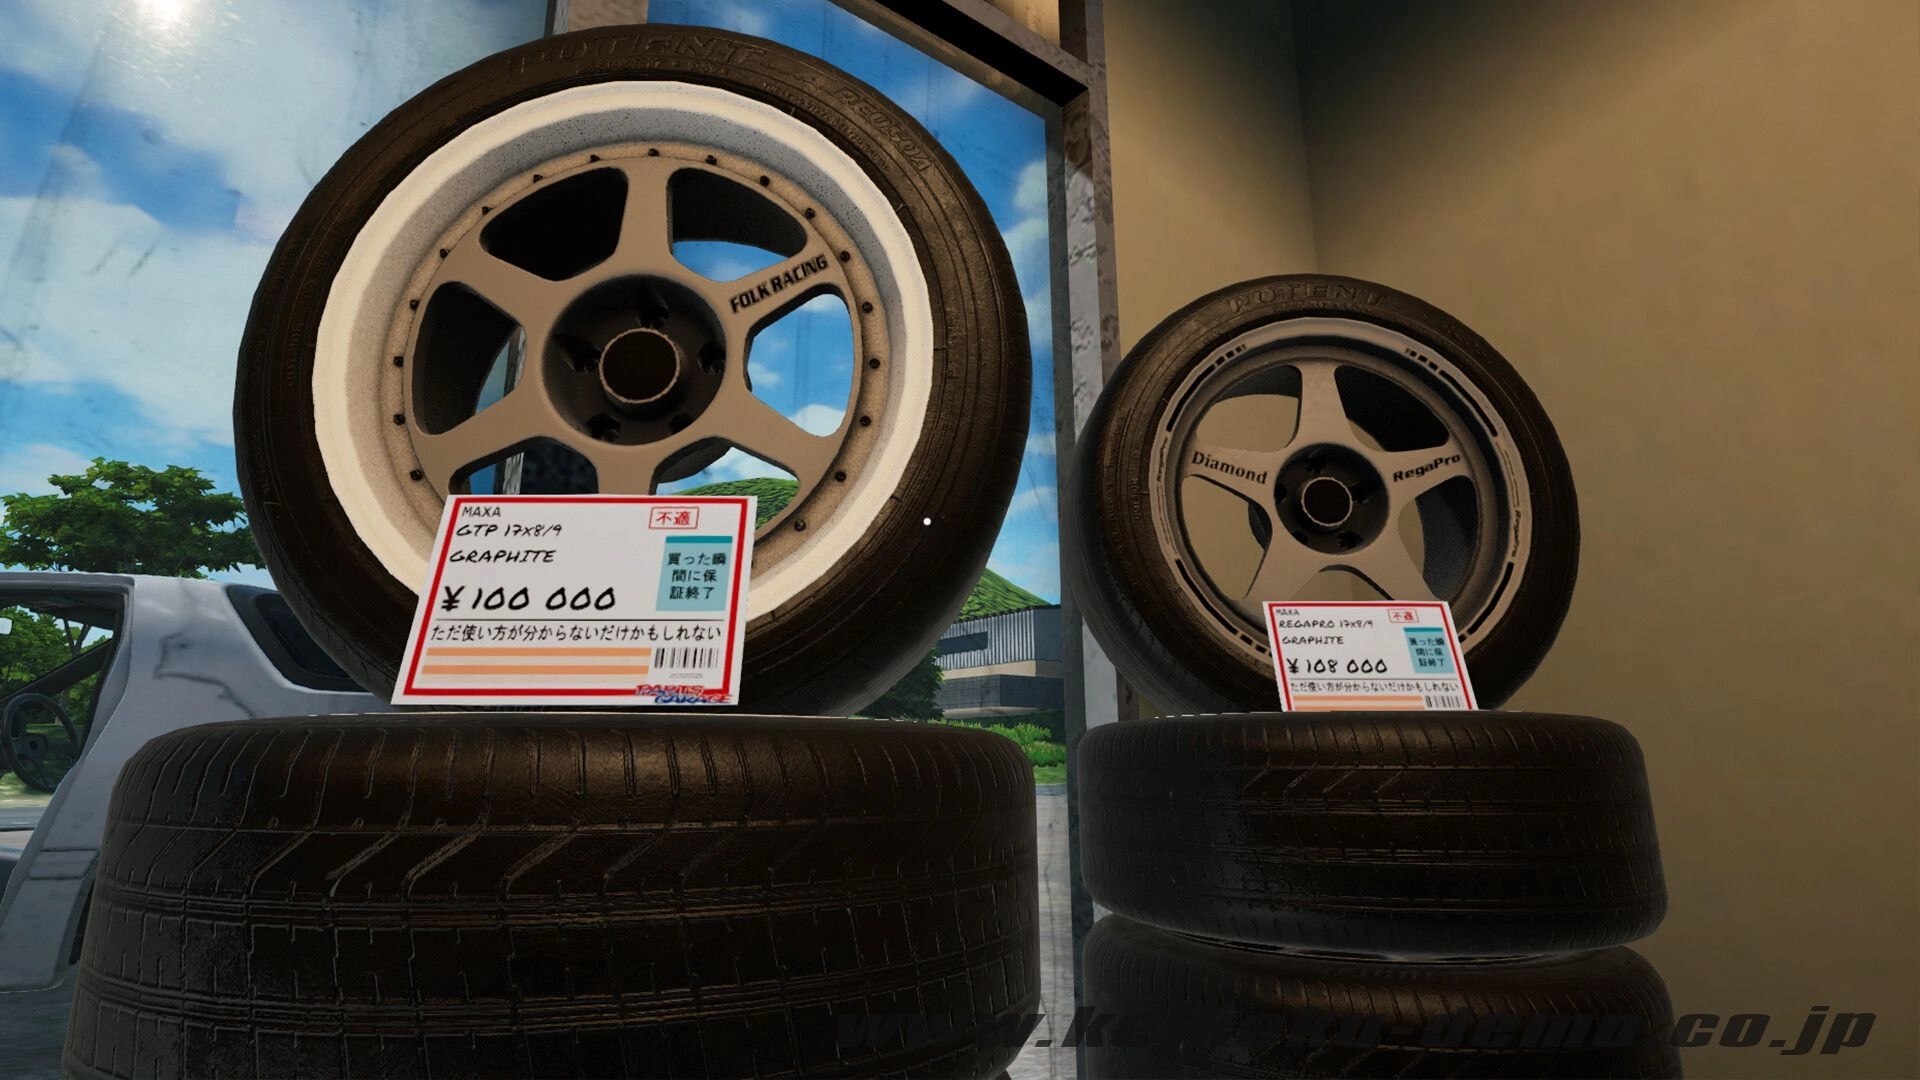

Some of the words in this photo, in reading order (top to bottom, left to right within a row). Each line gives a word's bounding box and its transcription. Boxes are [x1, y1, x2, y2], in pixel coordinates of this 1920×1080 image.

[506, 34, 766, 78] POTENT
[730, 283, 771, 313] FOLK
[771, 255, 828, 293] RACING
[1191, 451, 1267, 485] Diamond
[1393, 453, 1460, 482] RegaPro
[462, 506, 501, 518] MAXA
[655, 510, 691, 528] 不適
[456, 524, 499, 538] GTP
[449, 549, 557, 564] GRAPHITE
[667, 552, 727, 567] 買った瞬
[671, 568, 717, 583] 間に保
[545, 586, 616, 611] 000
[669, 585, 716, 601] 証終了
[1276, 608, 1300, 616] MAXA
[1279, 619, 1335, 629] REGAPRO
[431, 622, 722, 643] ただ使い方が分からないだけかもしれない
[1282, 635, 1344, 646] GRAPHITE
[1346, 659, 1388, 675] 000
